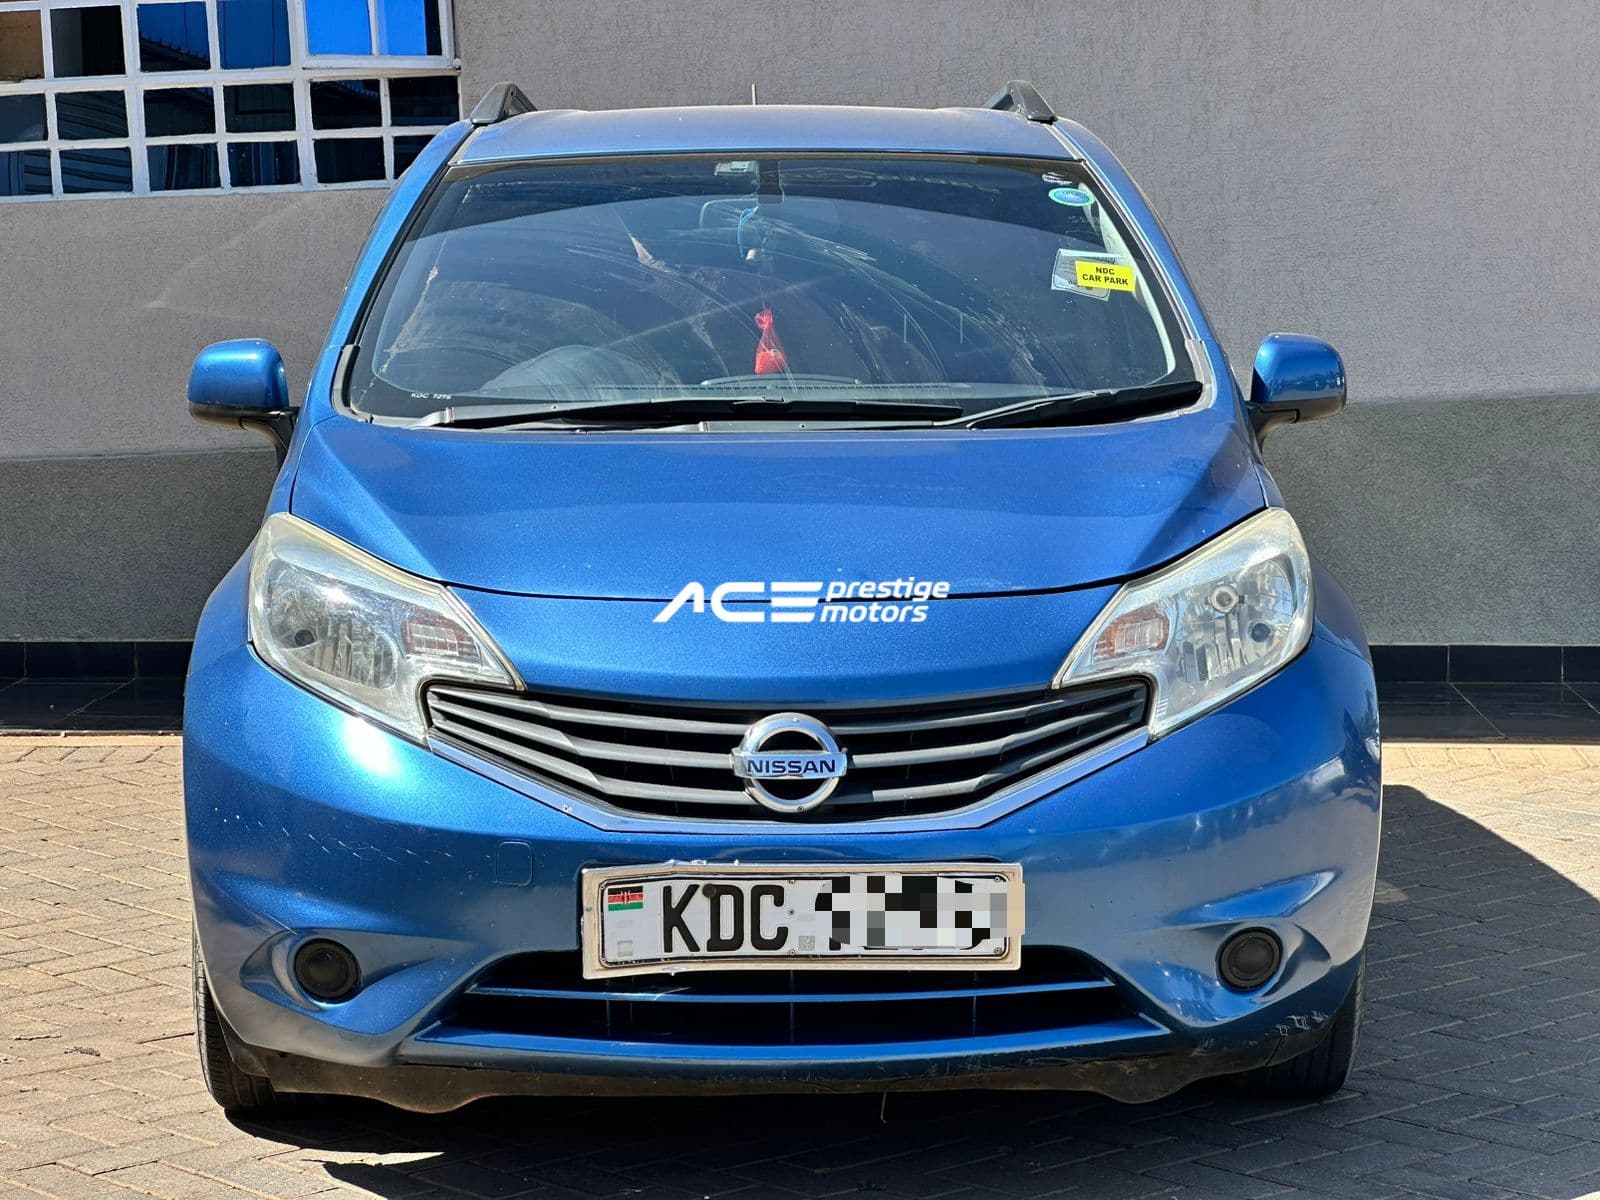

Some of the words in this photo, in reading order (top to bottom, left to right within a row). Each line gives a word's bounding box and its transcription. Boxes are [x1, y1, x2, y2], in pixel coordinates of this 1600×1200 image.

[1095, 267, 1115, 275] NDC
[1082, 274, 1101, 282] CAR
[1104, 276, 1129, 285] PARK
[747, 760, 836, 774] NISSAN
[662, 883, 788, 953] KDC
